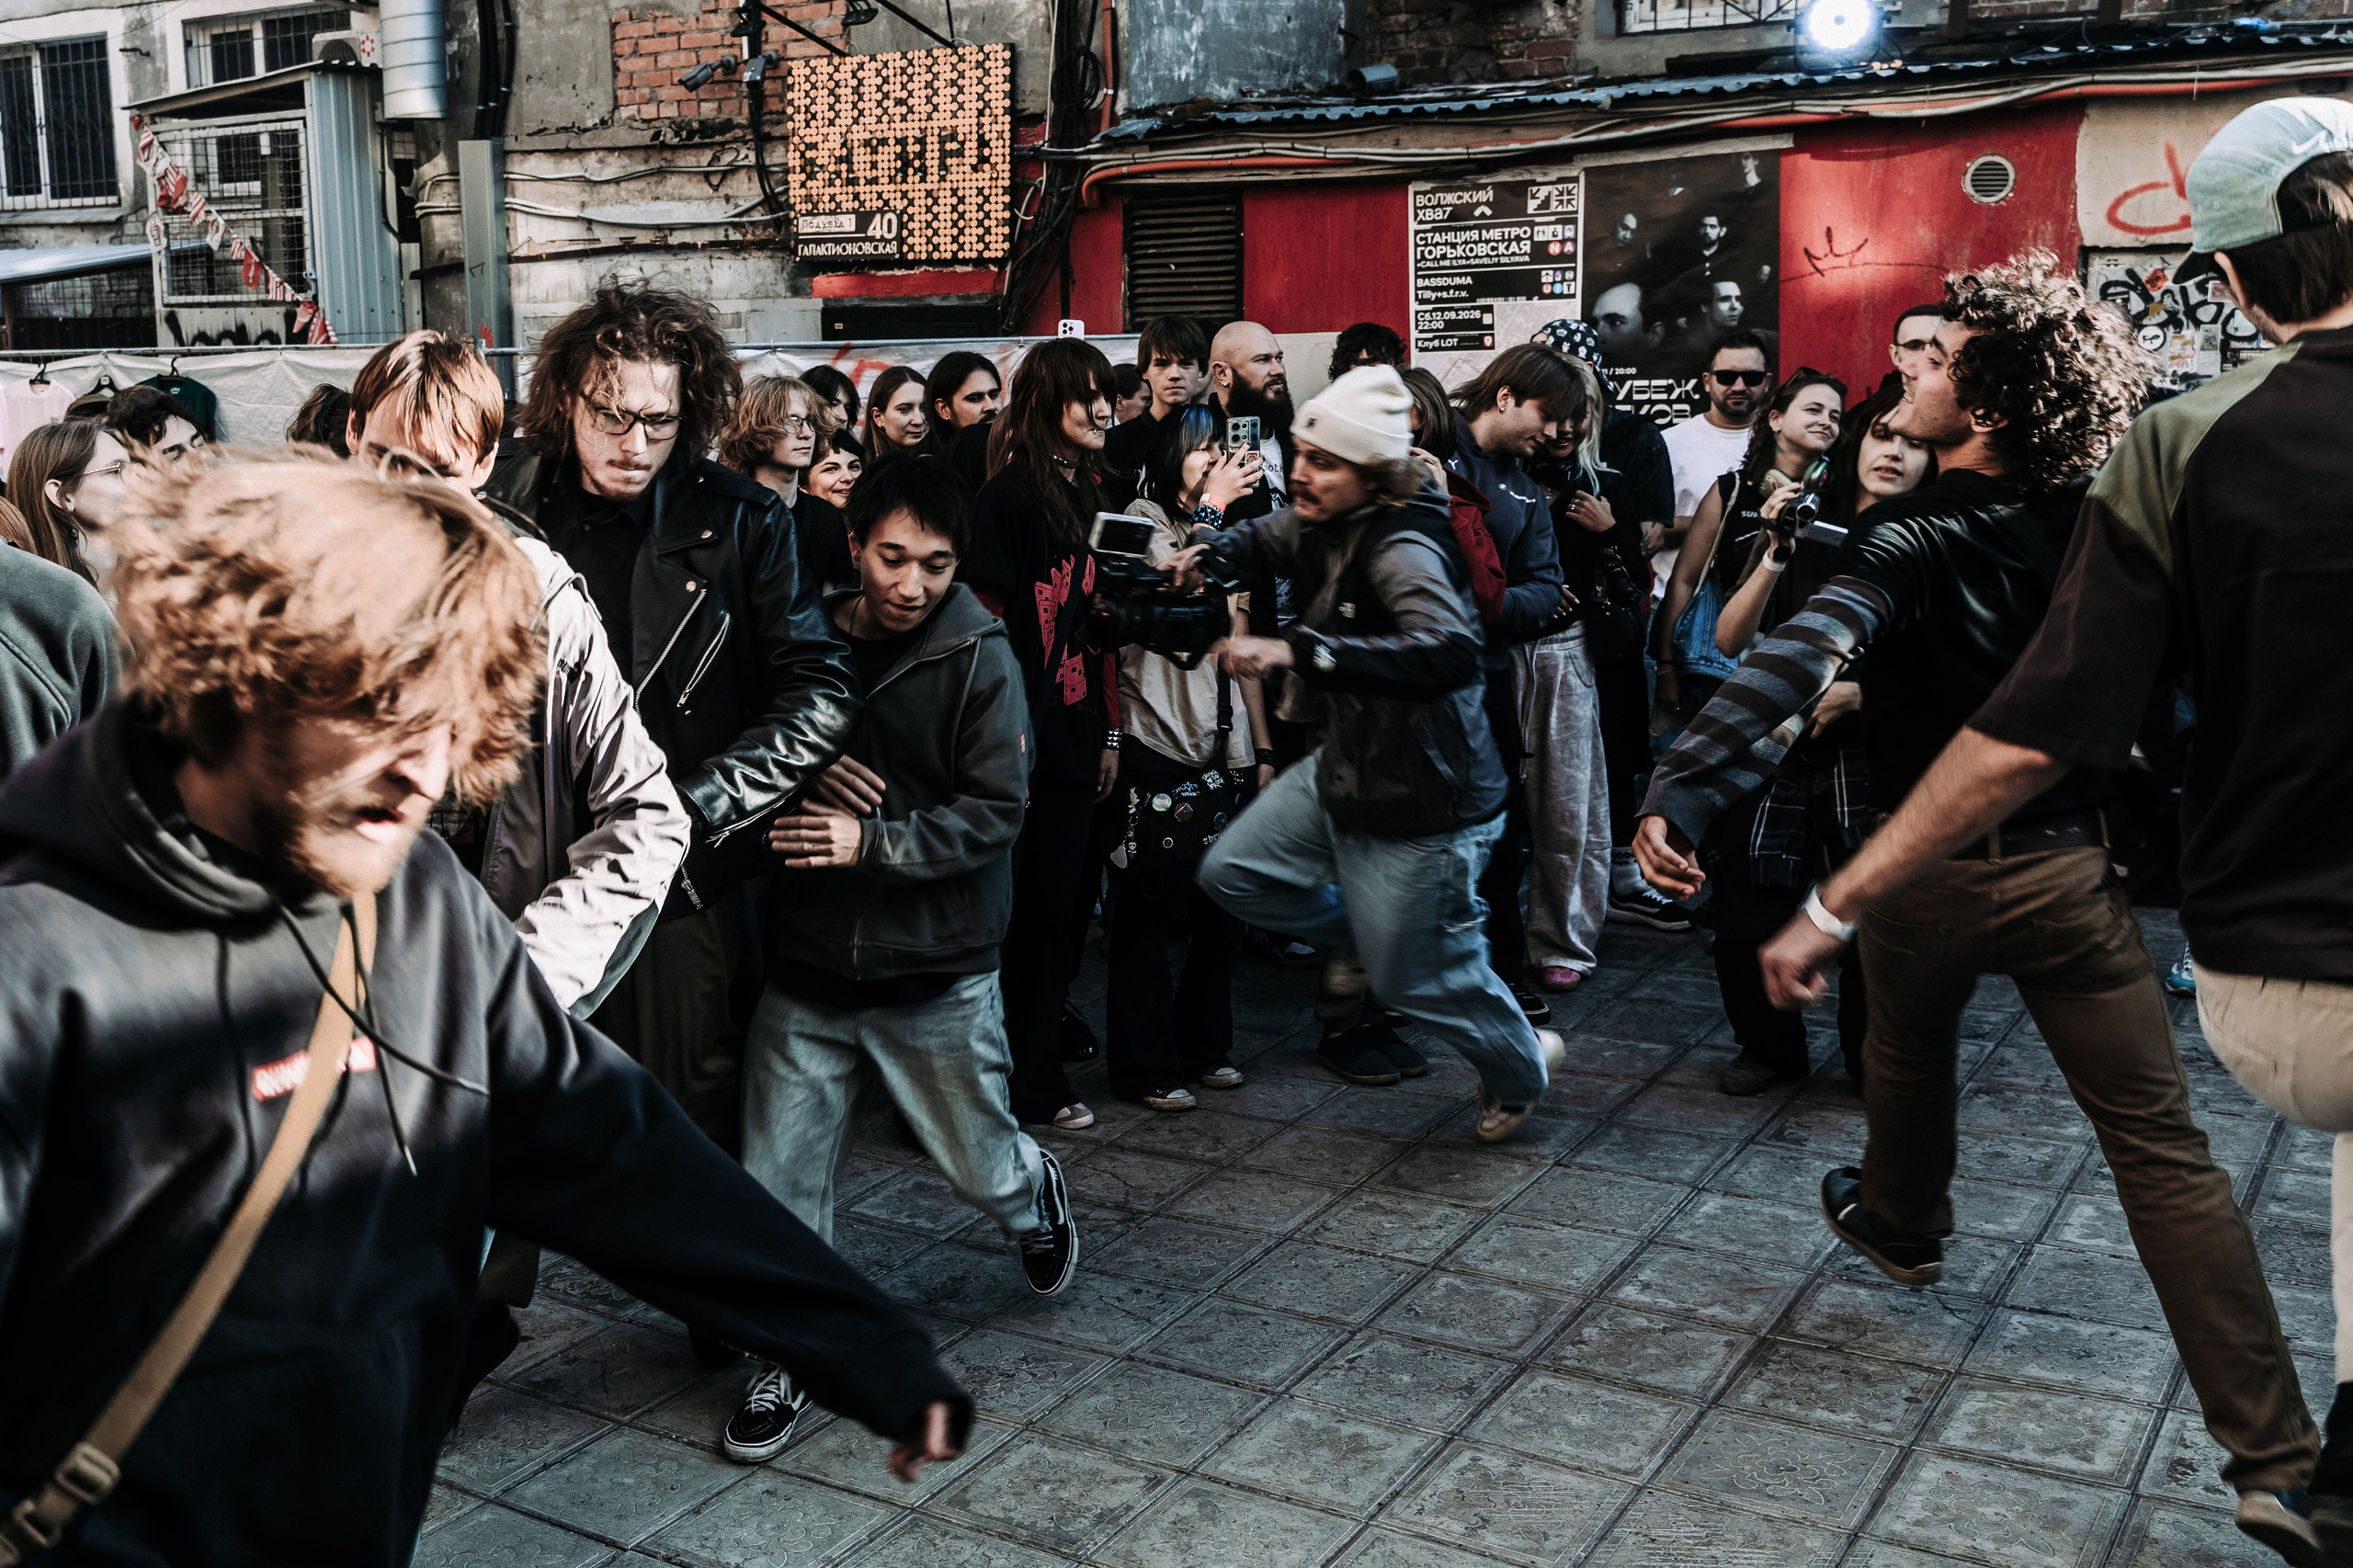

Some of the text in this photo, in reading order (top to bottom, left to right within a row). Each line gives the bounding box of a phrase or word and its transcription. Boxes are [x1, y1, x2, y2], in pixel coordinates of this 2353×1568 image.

[1415, 186, 1495, 207] ВОЛЖСКИЙ
[867, 211, 898, 239] 40
[1415, 226, 1531, 245] СТАНЦИЯ МЕТРО
[798, 241, 898, 256] ГАЛАКТИОНОВСКАЯ
[1416, 240, 1531, 260] ГОРЬКОВСКАЯ
[1416, 276, 1473, 289] BASSDUMA
[1417, 321, 1445, 330] 22:00
[1417, 339, 1439, 349] Клуб
[1441, 338, 1459, 347] LOT
[1608, 379, 1700, 401] УБЕЖ
